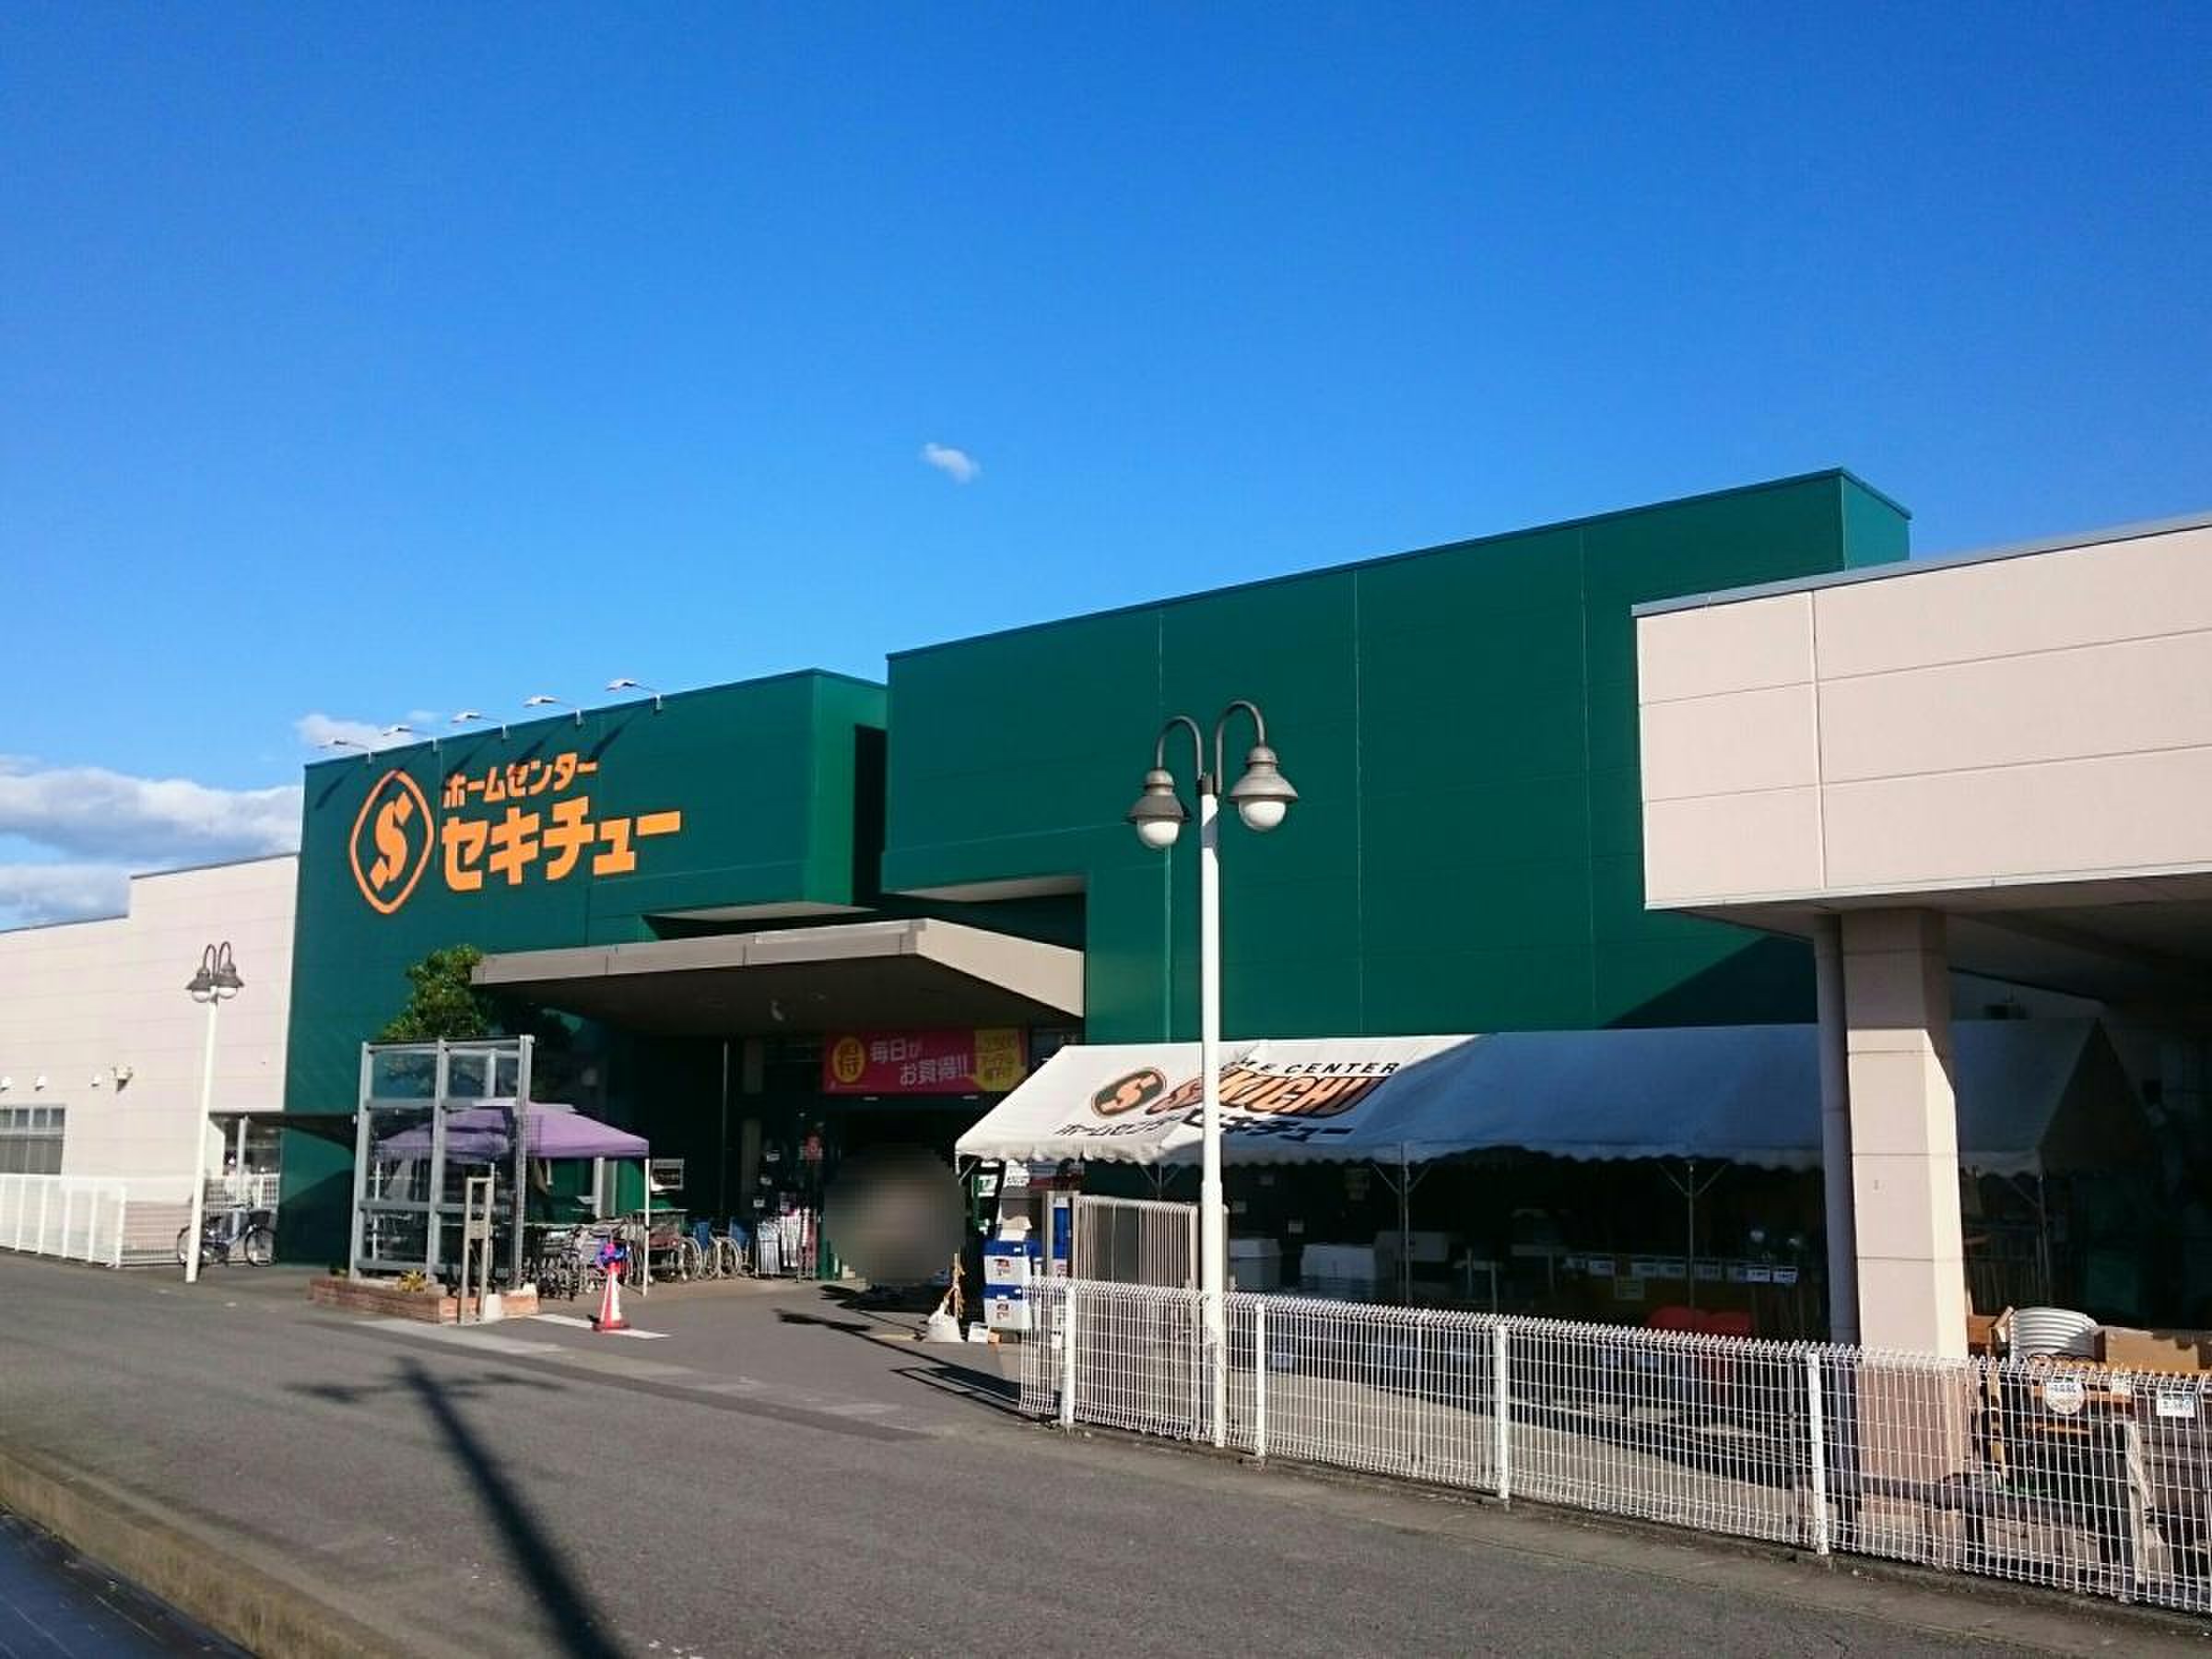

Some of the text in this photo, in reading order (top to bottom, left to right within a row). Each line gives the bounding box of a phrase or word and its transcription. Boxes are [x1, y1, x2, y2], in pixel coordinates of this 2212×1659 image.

[442, 752, 598, 808] ホームセンター
[441, 796, 681, 892] セキチュー
[1285, 1062, 1400, 1075] CENTER
